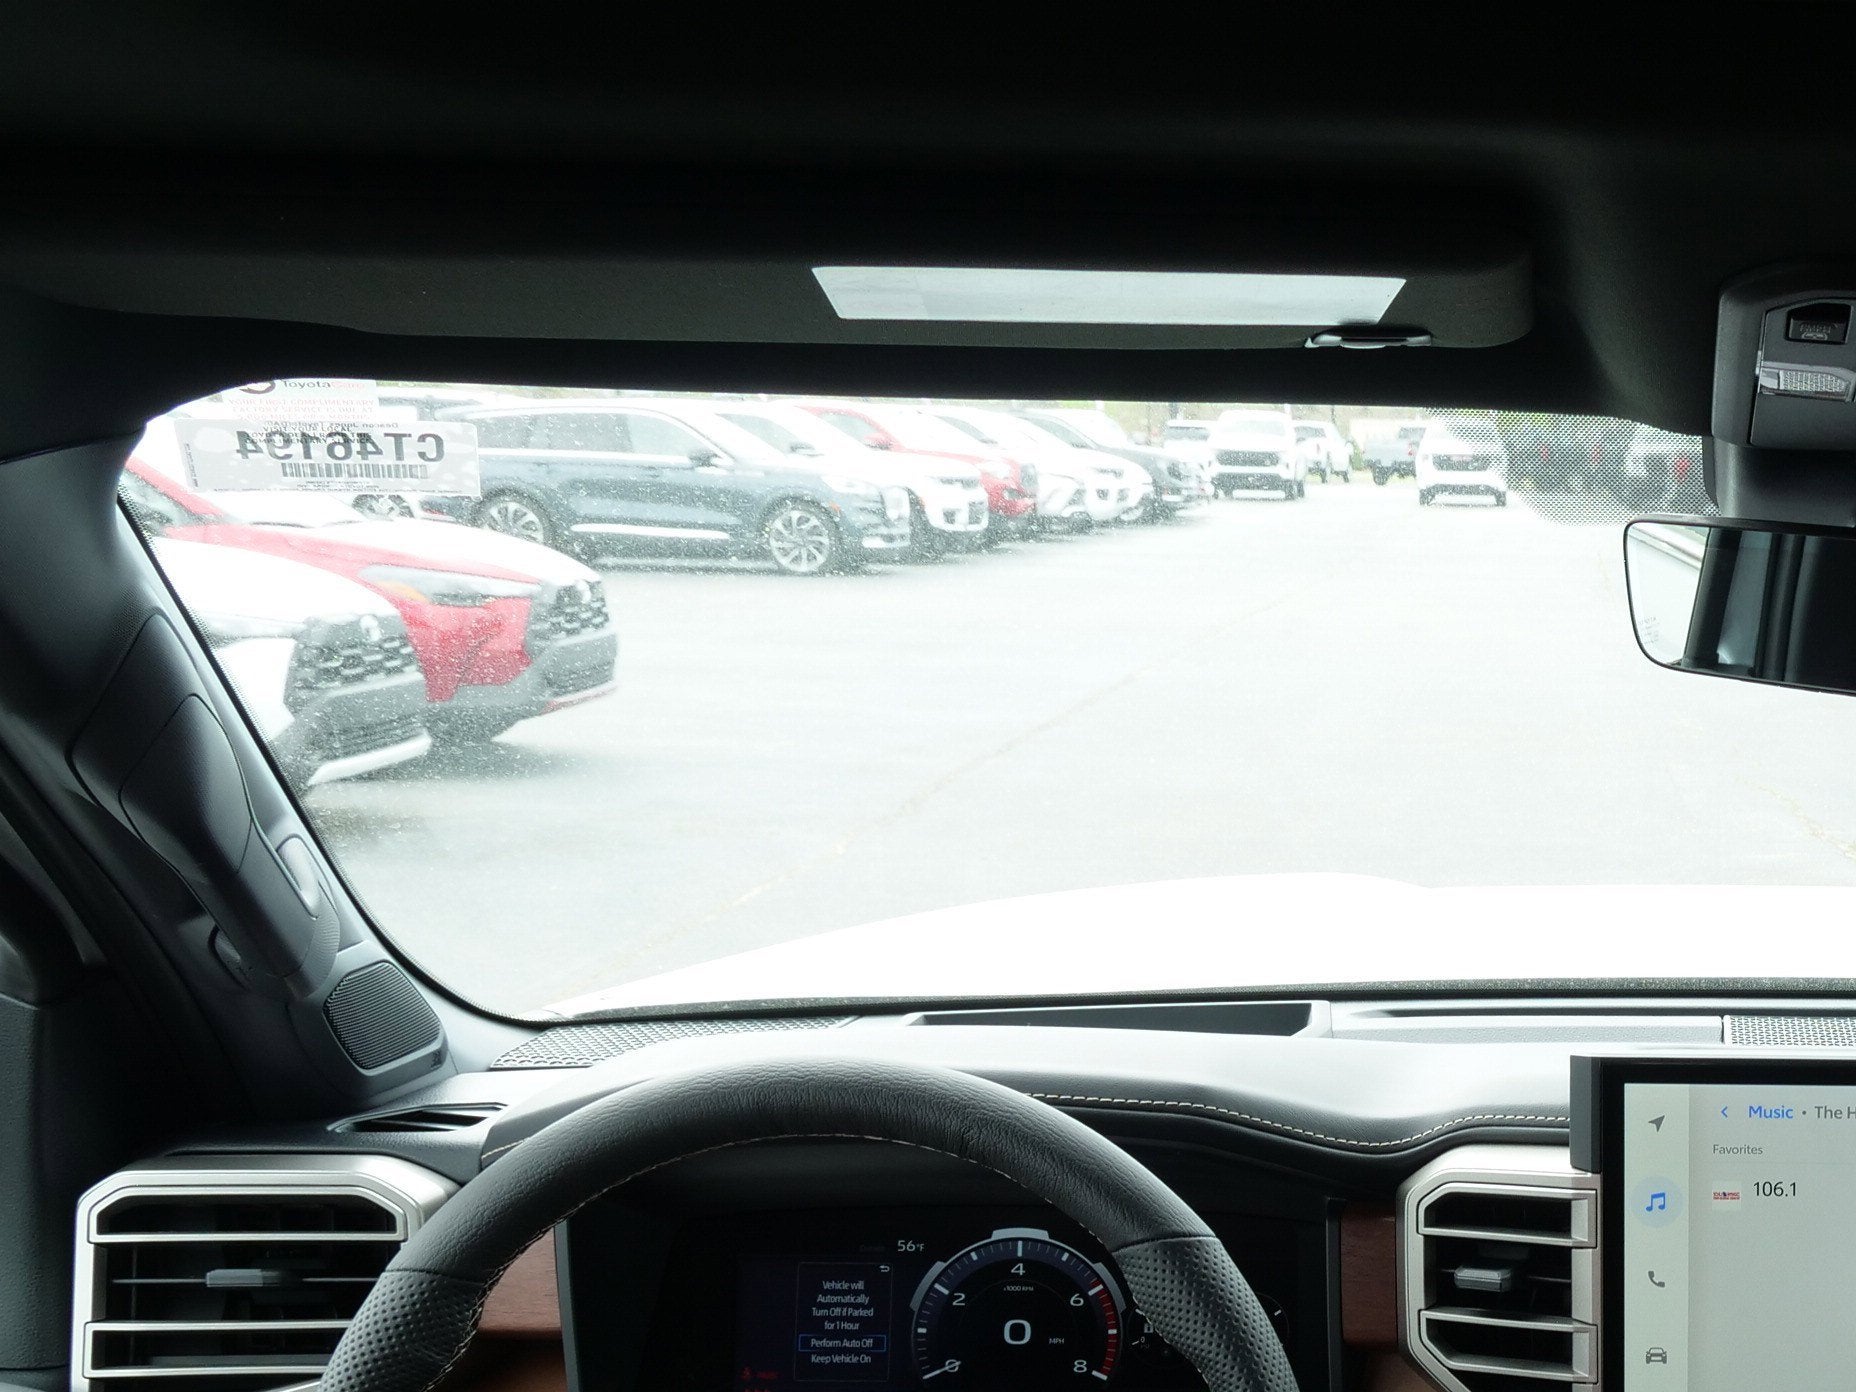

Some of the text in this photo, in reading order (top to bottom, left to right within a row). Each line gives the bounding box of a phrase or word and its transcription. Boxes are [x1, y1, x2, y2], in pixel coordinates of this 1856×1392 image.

[1748, 1105, 1794, 1120] Music
[1815, 1106, 1842, 1120] The
[1712, 1144, 1763, 1155] Favorites
[1753, 1181, 1798, 1197] 106.1
[1011, 1263, 1025, 1276] 4
[822, 1281, 864, 1290] Vehicle will
[817, 1294, 869, 1305] Automatically
[952, 1294, 965, 1306] 2
[1070, 1294, 1084, 1307] 6
[812, 1307, 828, 1317] Turn
[828, 1307, 841, 1317] Off
[847, 1307, 873, 1317] Parked
[824, 1321, 836, 1330] for
[841, 1321, 860, 1330] Hour
[1003, 1319, 1031, 1345] 0
[811, 1338, 873, 1348] Perform Auto Off
[1049, 1337, 1065, 1345] MPH
[811, 1354, 871, 1365] Keep Vehicle On
[1073, 1360, 1088, 1373] 8
